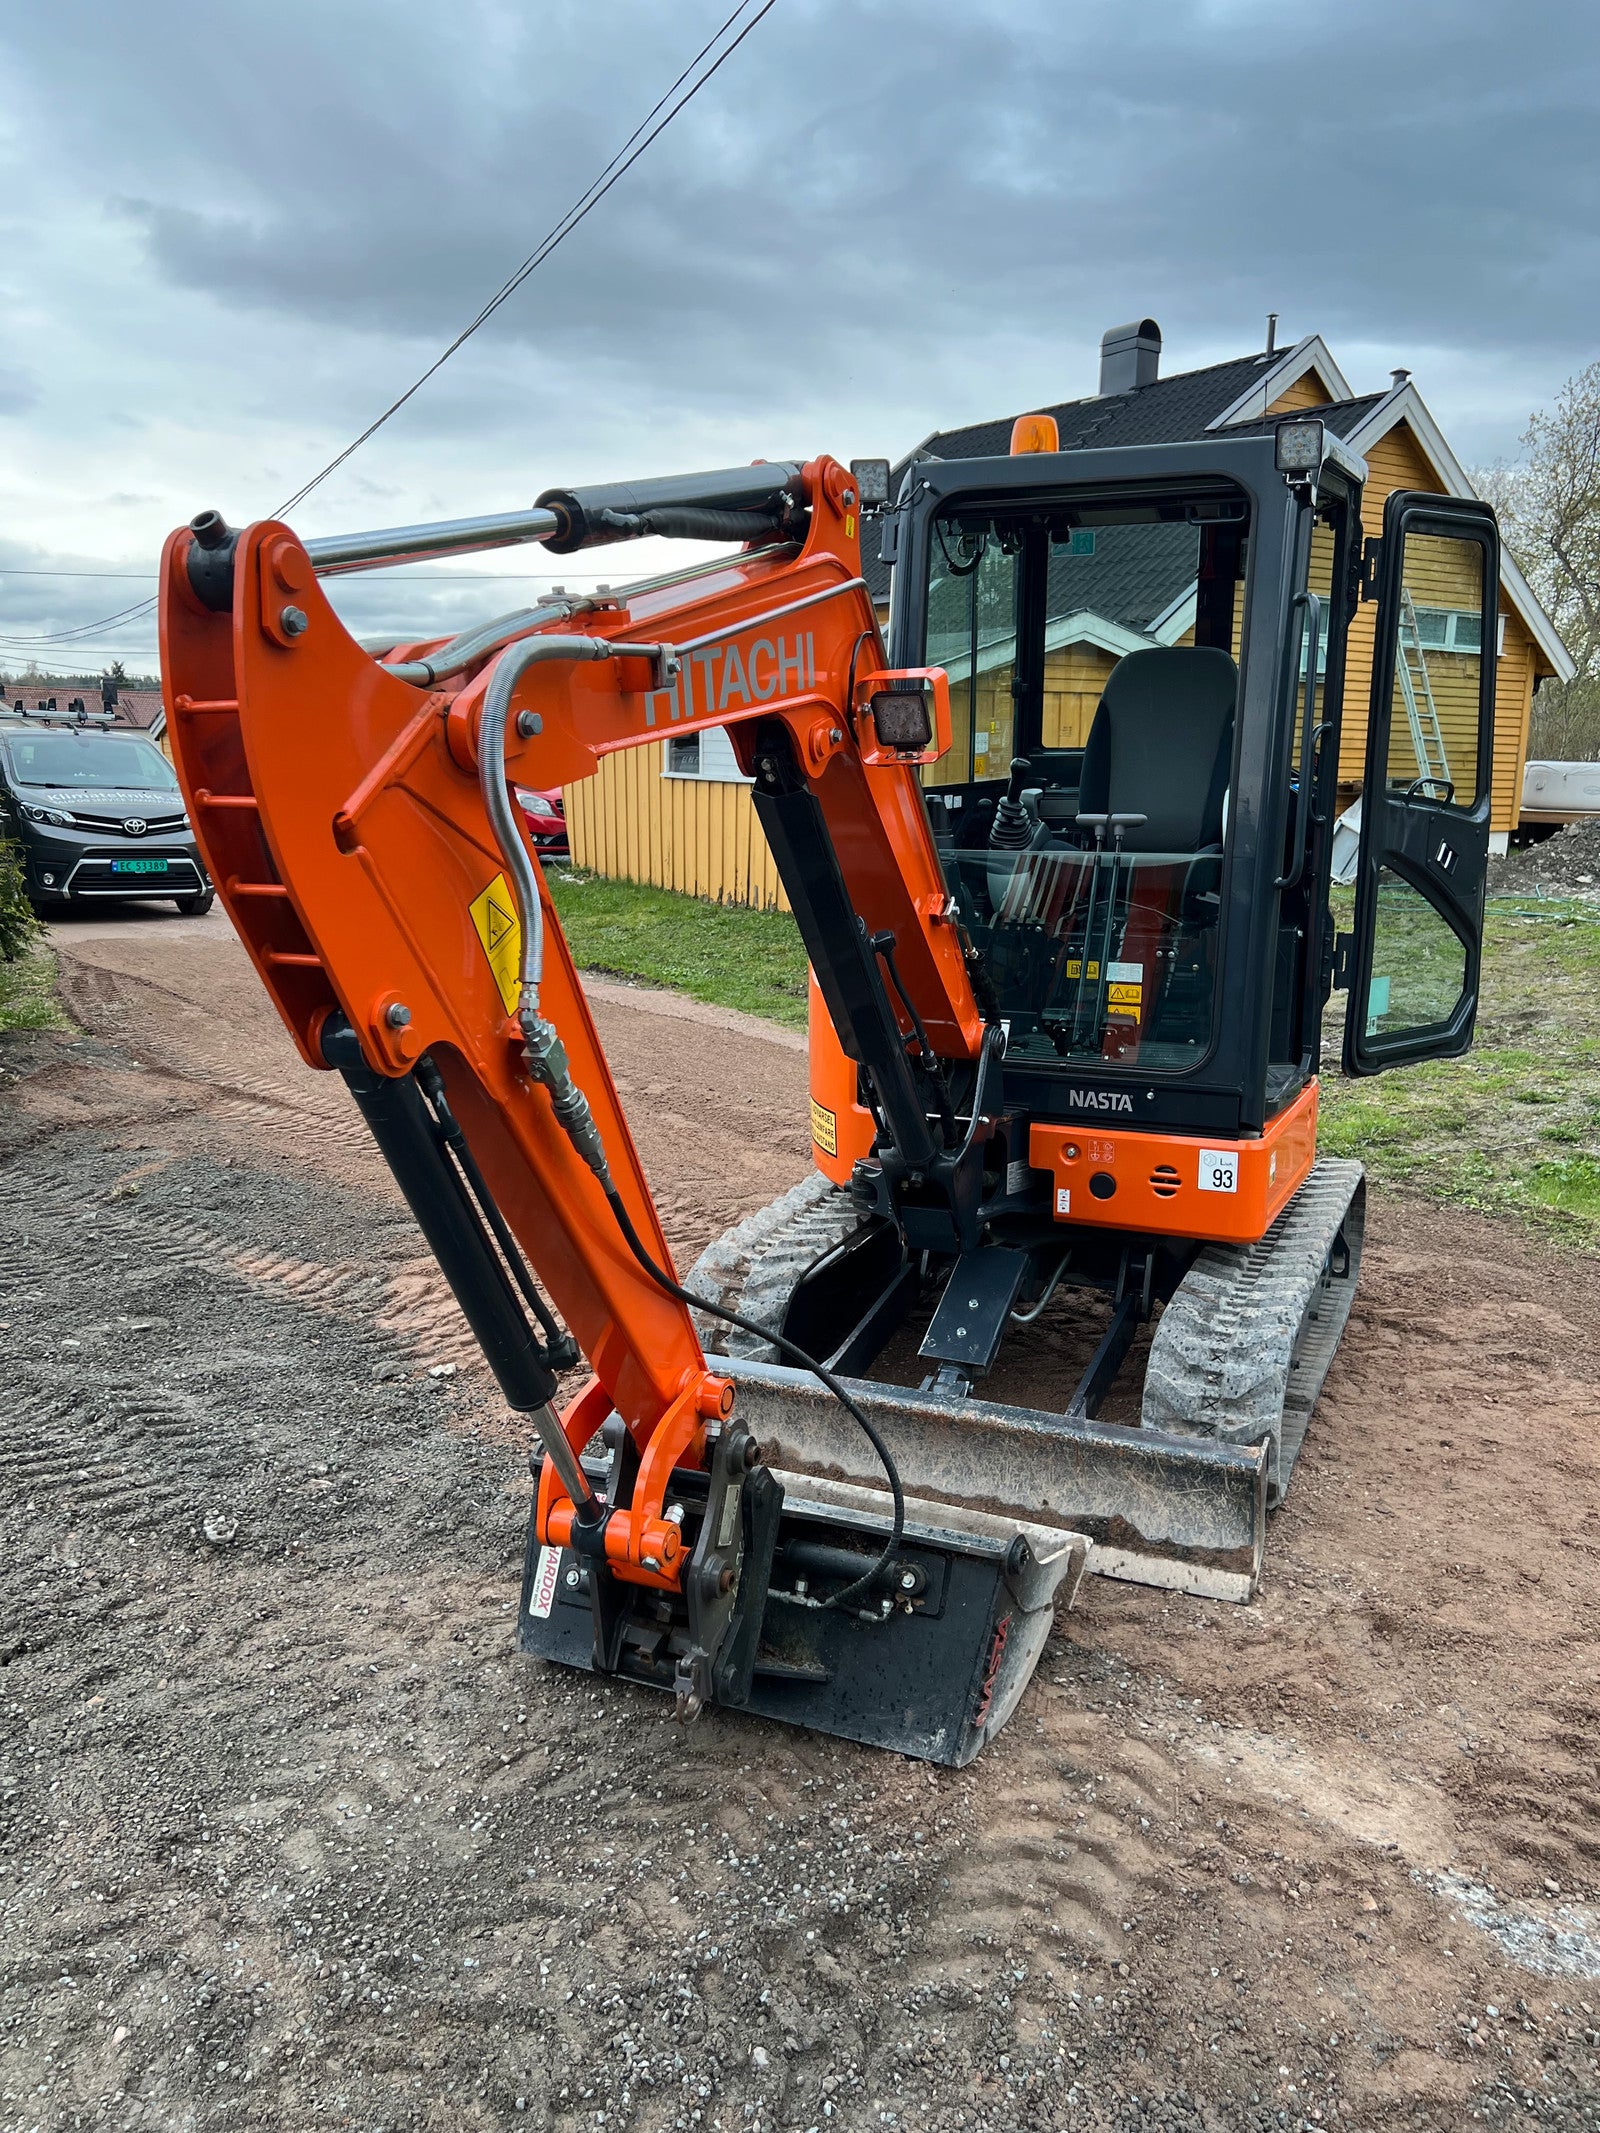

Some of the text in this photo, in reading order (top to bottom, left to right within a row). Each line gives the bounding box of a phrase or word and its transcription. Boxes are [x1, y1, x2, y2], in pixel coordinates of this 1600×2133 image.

[644, 631, 816, 727] HITACHI
[120, 861, 165, 871] EC 53389
[1069, 1089, 1133, 1112] NASTA
[1212, 1168, 1233, 1188] 93
[537, 1547, 560, 1612] HARDOX
[975, 1615, 1011, 1727] NASTA
